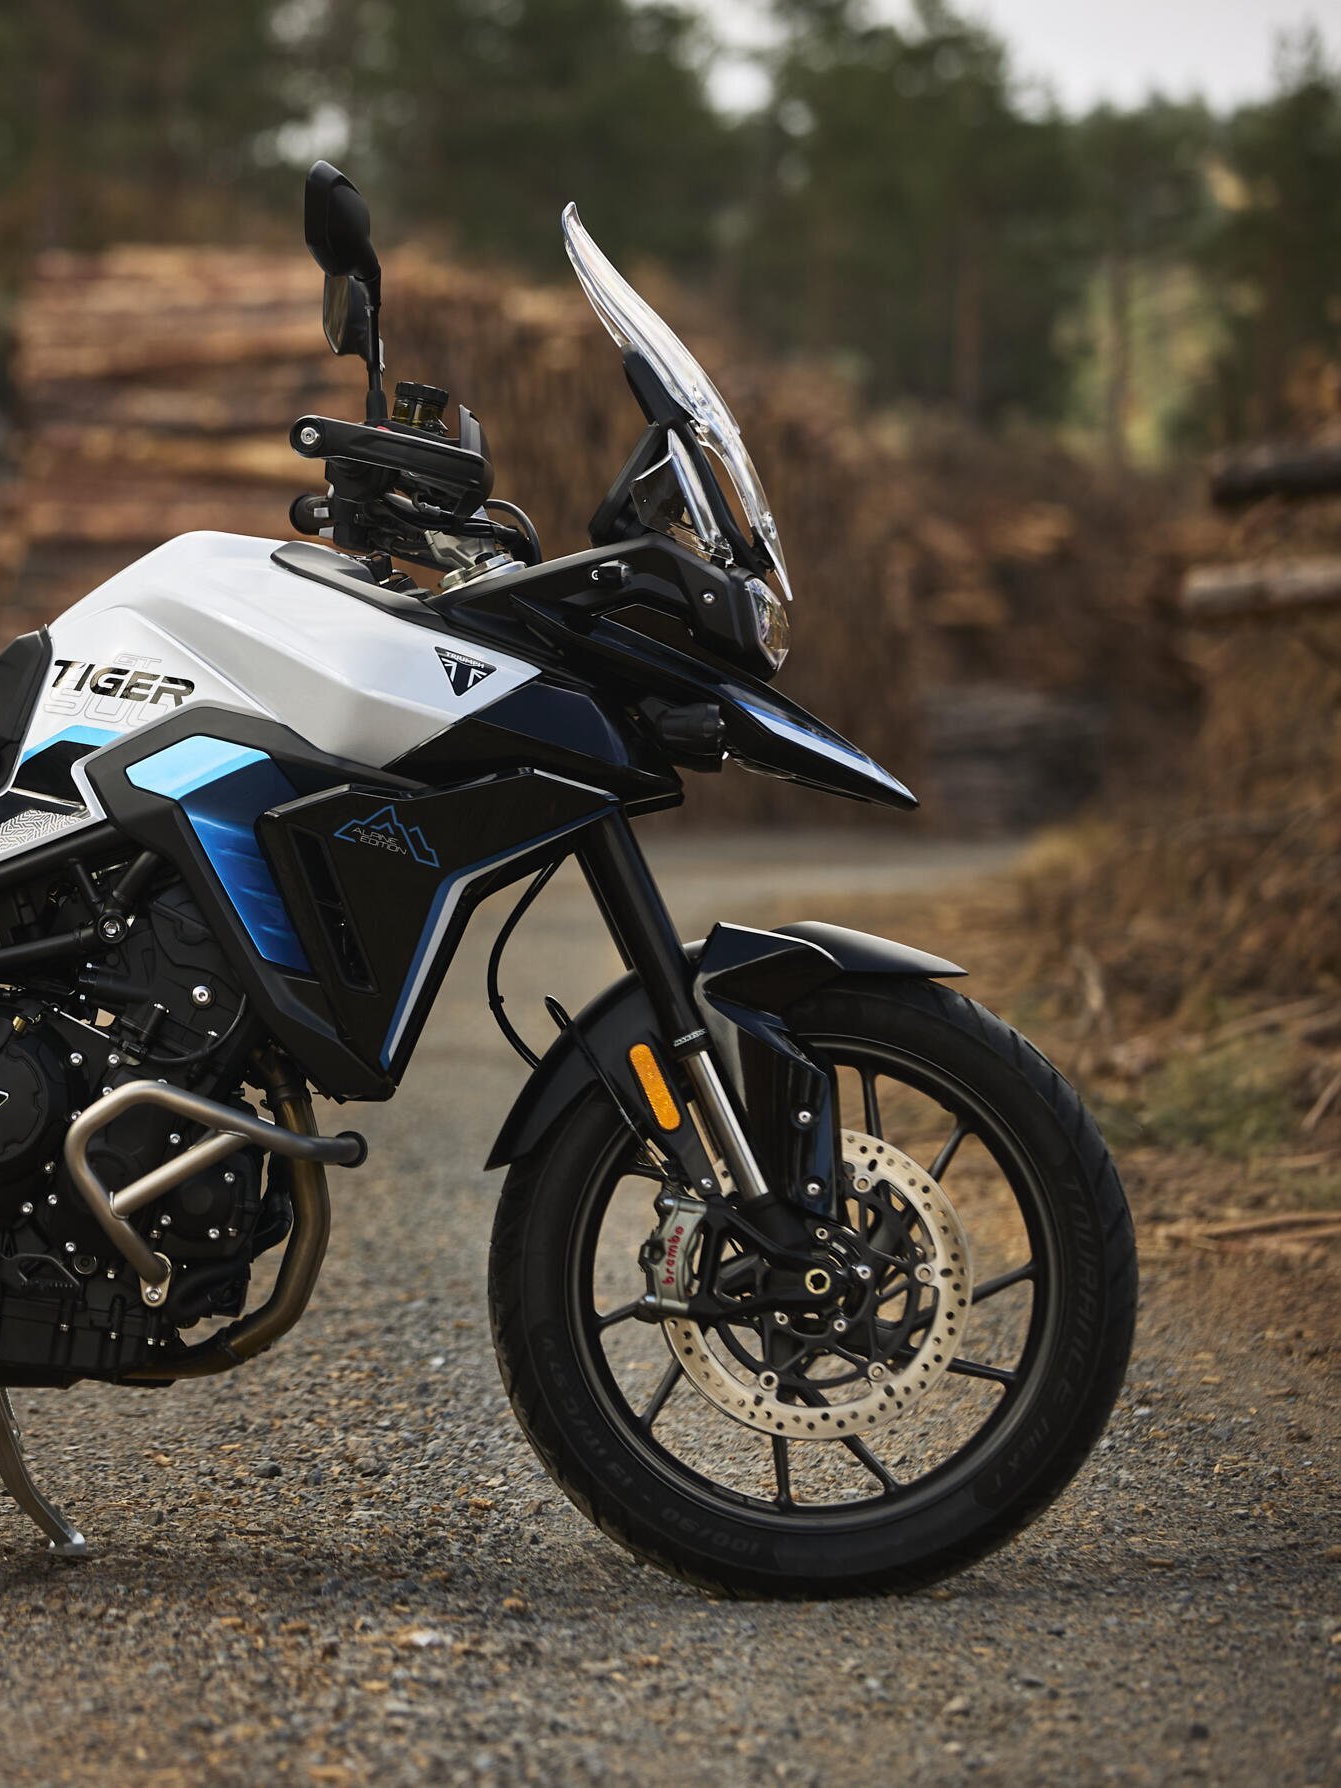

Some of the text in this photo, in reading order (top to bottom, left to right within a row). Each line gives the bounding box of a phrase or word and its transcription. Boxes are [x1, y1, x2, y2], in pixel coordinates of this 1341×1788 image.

[113, 653, 162, 670] GT
[445, 651, 485, 669] TRIUMPH
[52, 660, 195, 707] TIGER
[352, 827, 399, 846] ALPINE
[360, 835, 407, 855] EDITION
[662, 1226, 684, 1284] brembo
[1053, 1175, 1100, 1409] TOURANCE
